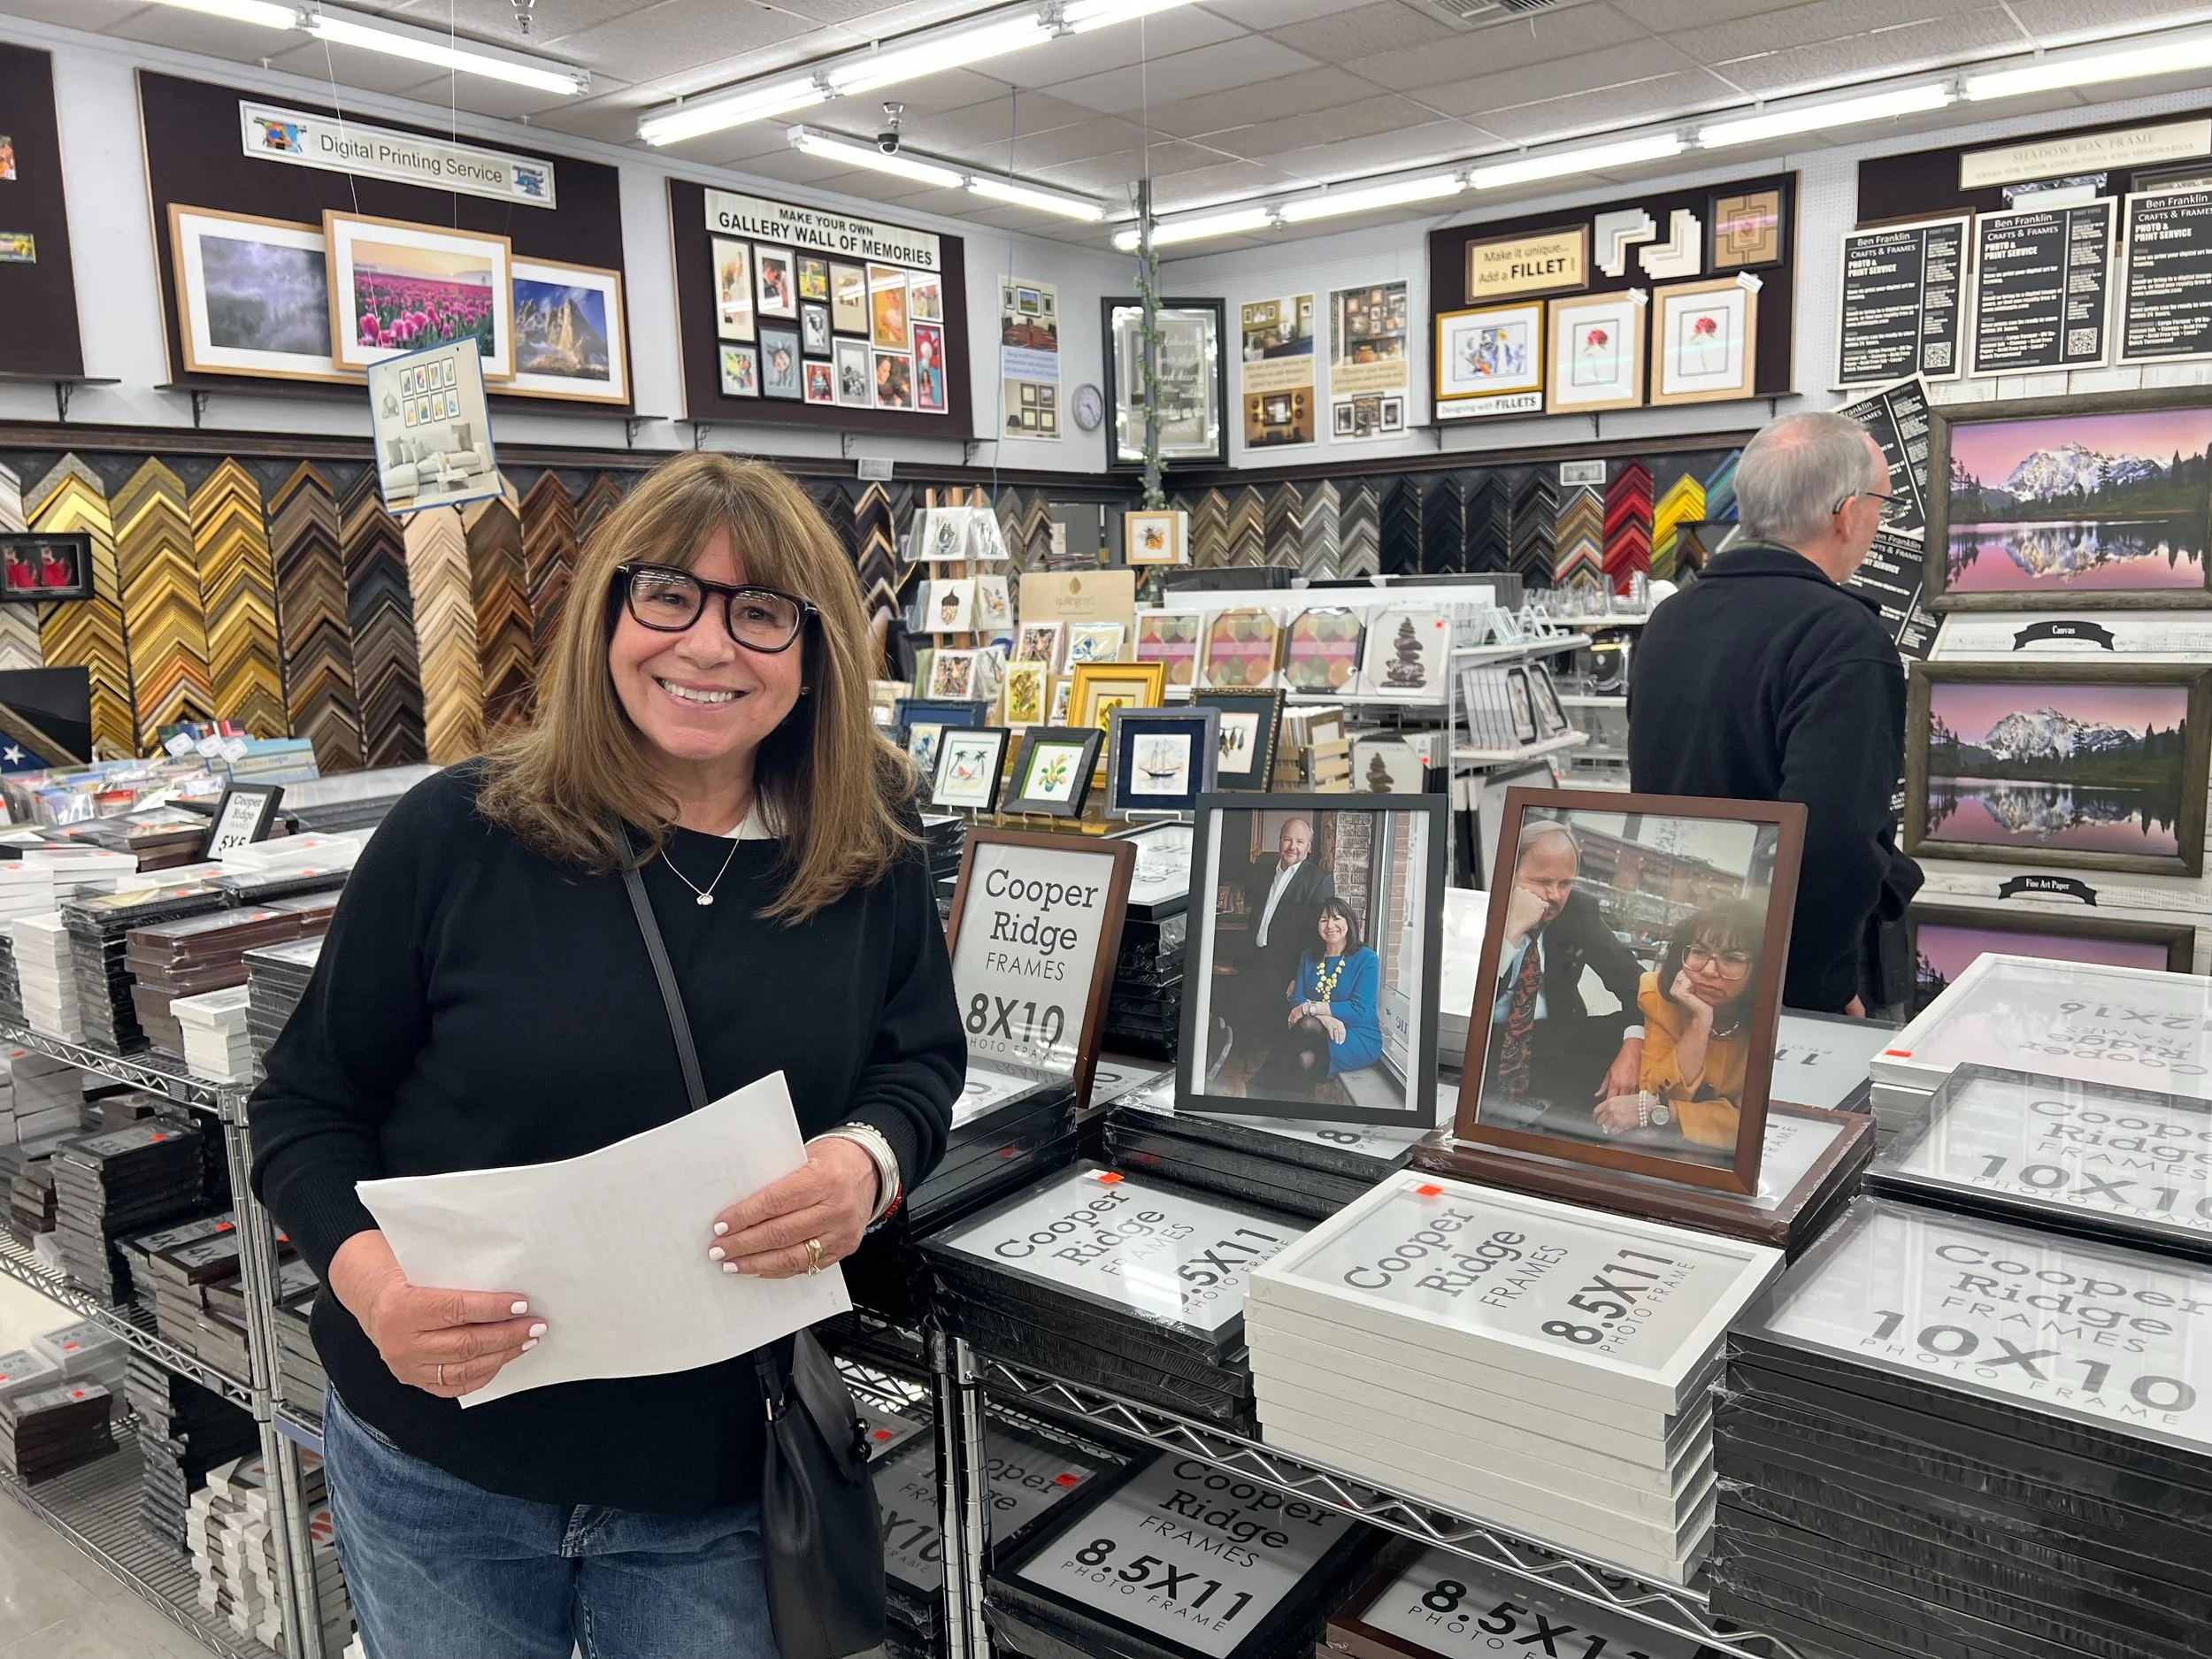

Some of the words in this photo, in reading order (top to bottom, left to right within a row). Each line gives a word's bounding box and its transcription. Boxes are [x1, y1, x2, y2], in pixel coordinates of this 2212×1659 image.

[319, 134, 373, 159] Digital
[380, 145, 441, 175] Printing
[446, 157, 502, 183] Service
[2012, 145, 2069, 163] SHADOW
[2075, 140, 2102, 154] BOX
[2108, 133, 2155, 149] FRAME
[779, 208, 813, 226] MAKE
[815, 215, 846, 231] YOUR
[849, 223, 874, 236] OWN
[1993, 219, 2013, 228] Ben
[2015, 213, 2053, 226] Franklin
[2146, 199, 2165, 209] Ben
[2168, 194, 2208, 206] Franklin
[2170, 210, 2178, 219] &
[718, 211, 790, 240] GALLERY
[795, 226, 834, 248] WALL
[840, 234, 858, 251] OF
[862, 240, 932, 265] MEMORIES
[1856, 237, 1874, 247] Ben
[1875, 232, 1911, 244] Franklin
[1985, 242, 2009, 252] PHOTO
[2017, 229, 2024, 238] &
[2134, 222, 2162, 234] PHOTO
[2134, 231, 2159, 243] PRINT
[2159, 227, 2193, 240] SERVICE
[1479, 272, 1500, 284] Add
[1501, 272, 1509, 281] a
[1510, 258, 1566, 280] FILLET
[1483, 251, 1512, 263] Make
[1515, 248, 1522, 259] it
[1847, 259, 1871, 269] PHOTO
[1847, 267, 1868, 278] PRINT
[1869, 263, 1898, 275] SERVICE
[1984, 250, 2007, 261] PRINT
[2007, 246, 2039, 258] SERVICE
[1495, 396, 1536, 410] FILLETS
[1887, 534, 1922, 550] Franklin
[1894, 548, 1924, 563] FRAMES
[2052, 625, 2076, 635] Canvas
[232, 809, 255, 823] Ridge
[234, 795, 263, 810] Cooper
[985, 868, 1099, 912] Cooper
[2025, 878, 2039, 888] Fine
[2039, 879, 2051, 889] Art
[2051, 880, 2070, 891] Paper
[989, 910, 1078, 956] Ridge
[986, 951, 1066, 981] FRAMES
[965, 992, 1065, 1049] 8X10
[970, 1038, 1006, 1053] HOTO
[2029, 1101, 2212, 1143] Coope
[2037, 1141, 2208, 1181] FRAMES
[1970, 1176, 2089, 1204] PHOTO
[2113, 1202, 2212, 1230] FRAM
[994, 1189, 1131, 1259] Cooper
[1051, 1210, 1165, 1267] Ridge
[1180, 1227, 1280, 1307] .5X11
[1343, 1206, 1476, 1291] Cooper
[1414, 1230, 1527, 1299] Ridge
[1181, 1277, 1239, 1316] PHOTO
[1479, 1244, 1569, 1310] FRAMES
[1540, 1248, 1676, 1347] 8.5X11
[1934, 1244, 2212, 1317] Cooper
[1599, 1307, 1653, 1355] PHOTO
[1646, 1261, 1696, 1303] FRAME
[1940, 1294, 2147, 1354] FRAMES
[1949, 1271, 2174, 1337] Ridge
[1859, 1337, 1999, 1380] PHOTO
[2029, 1379, 2181, 1427] FRAME
[1869, 1310, 2197, 1413] 10X10
[1172, 1459, 1338, 1527] Cooper
[1158, 1488, 1290, 1549] Ridge
[1139, 1515, 1261, 1569] FRAMES
[1061, 1560, 1136, 1595] PHOTO
[1146, 1594, 1227, 1632] FRAME
[1075, 1538, 1254, 1623] 8.5X11
[1407, 1605, 1505, 1650] PHOTO
